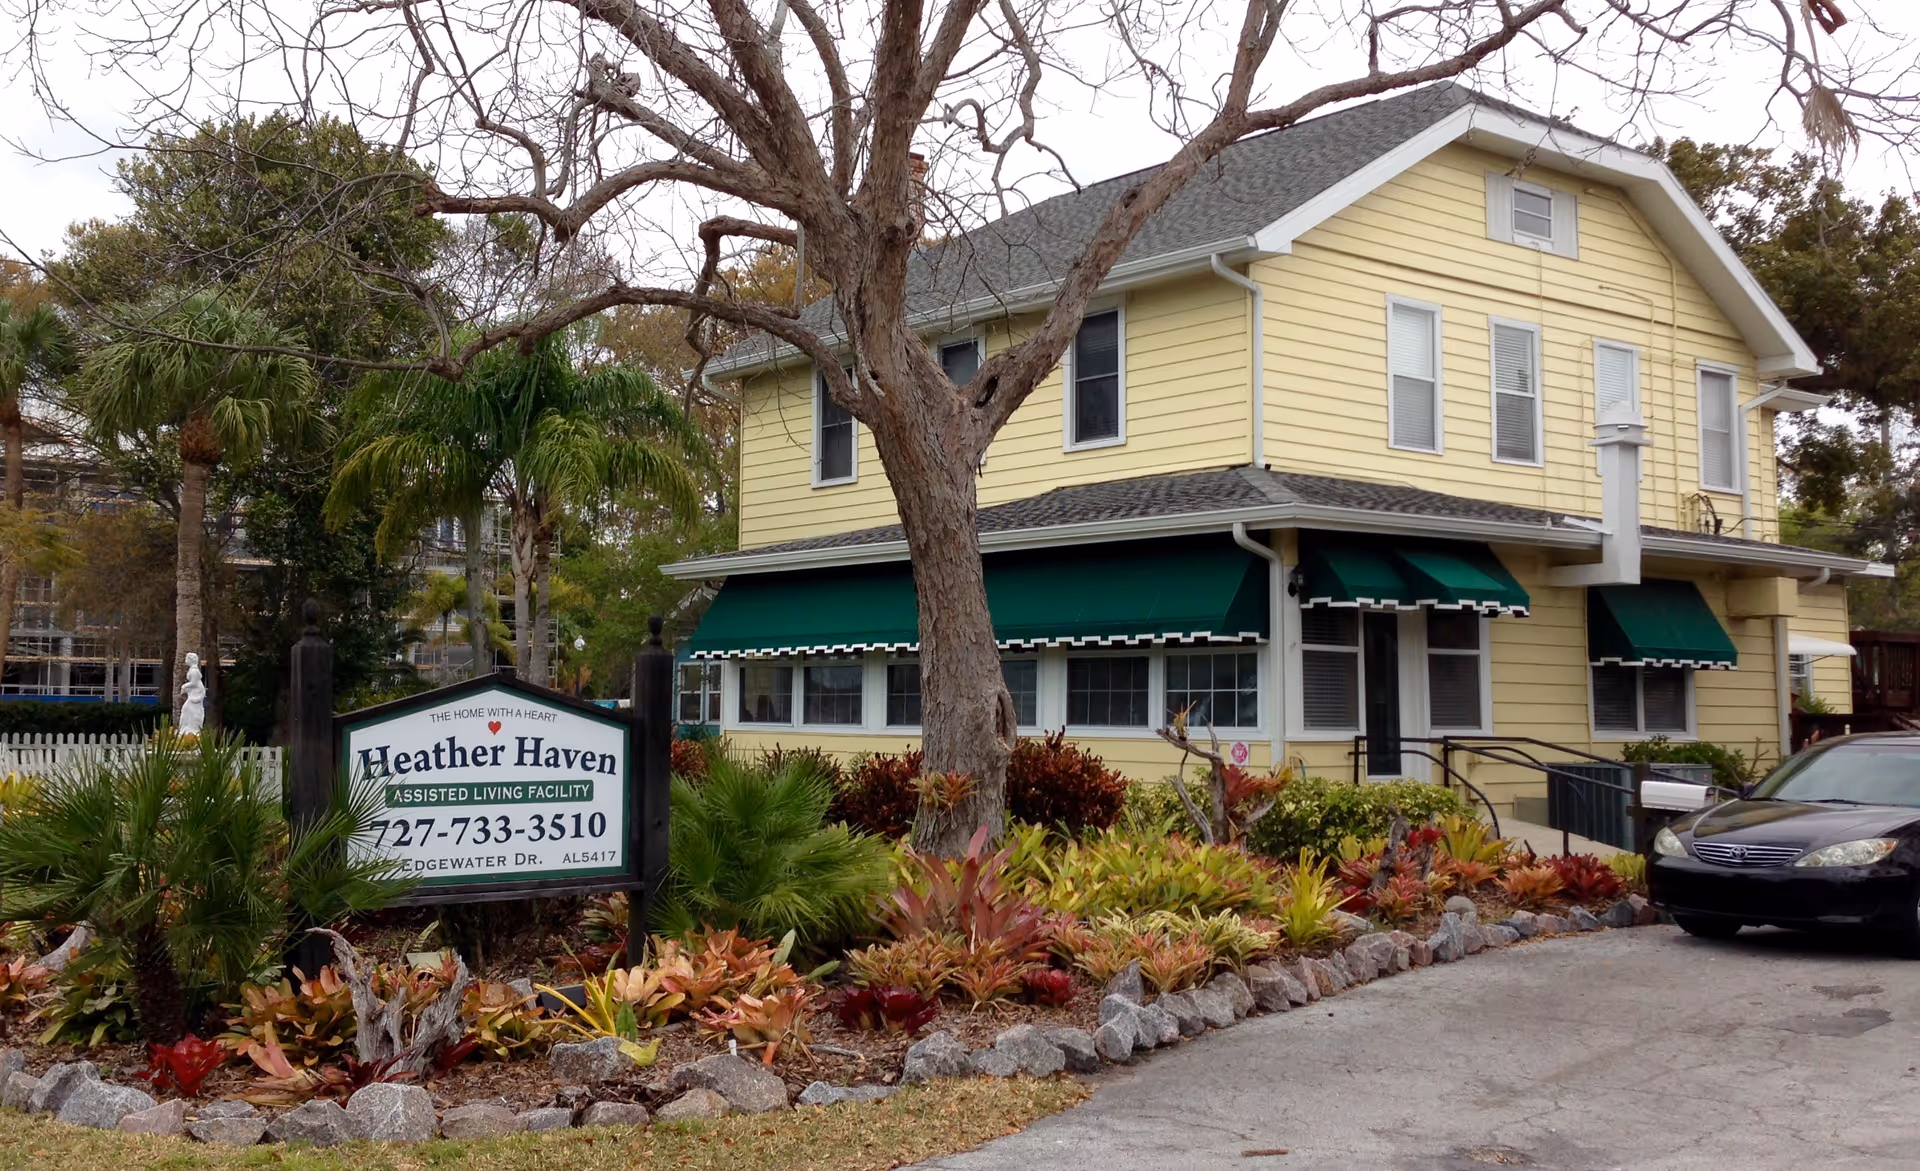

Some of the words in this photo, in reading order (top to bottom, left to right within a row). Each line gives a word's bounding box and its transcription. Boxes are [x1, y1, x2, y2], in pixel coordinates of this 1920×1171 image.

[430, 711, 451, 723] THE
[454, 708, 484, 719] HOME
[487, 707, 513, 717] WITH
[515, 709, 522, 718] A
[524, 710, 557, 722] HEART
[358, 736, 506, 780] Heather
[514, 736, 616, 775] Haven
[394, 787, 468, 803] ASSISTED
[473, 786, 523, 801] LIVING
[528, 784, 590, 798] FACILITY
[369, 811, 606, 849] 727-733-3510
[402, 855, 507, 872] EDGEWATER
[515, 852, 543, 866] DR.
[562, 850, 616, 864] AL5417
